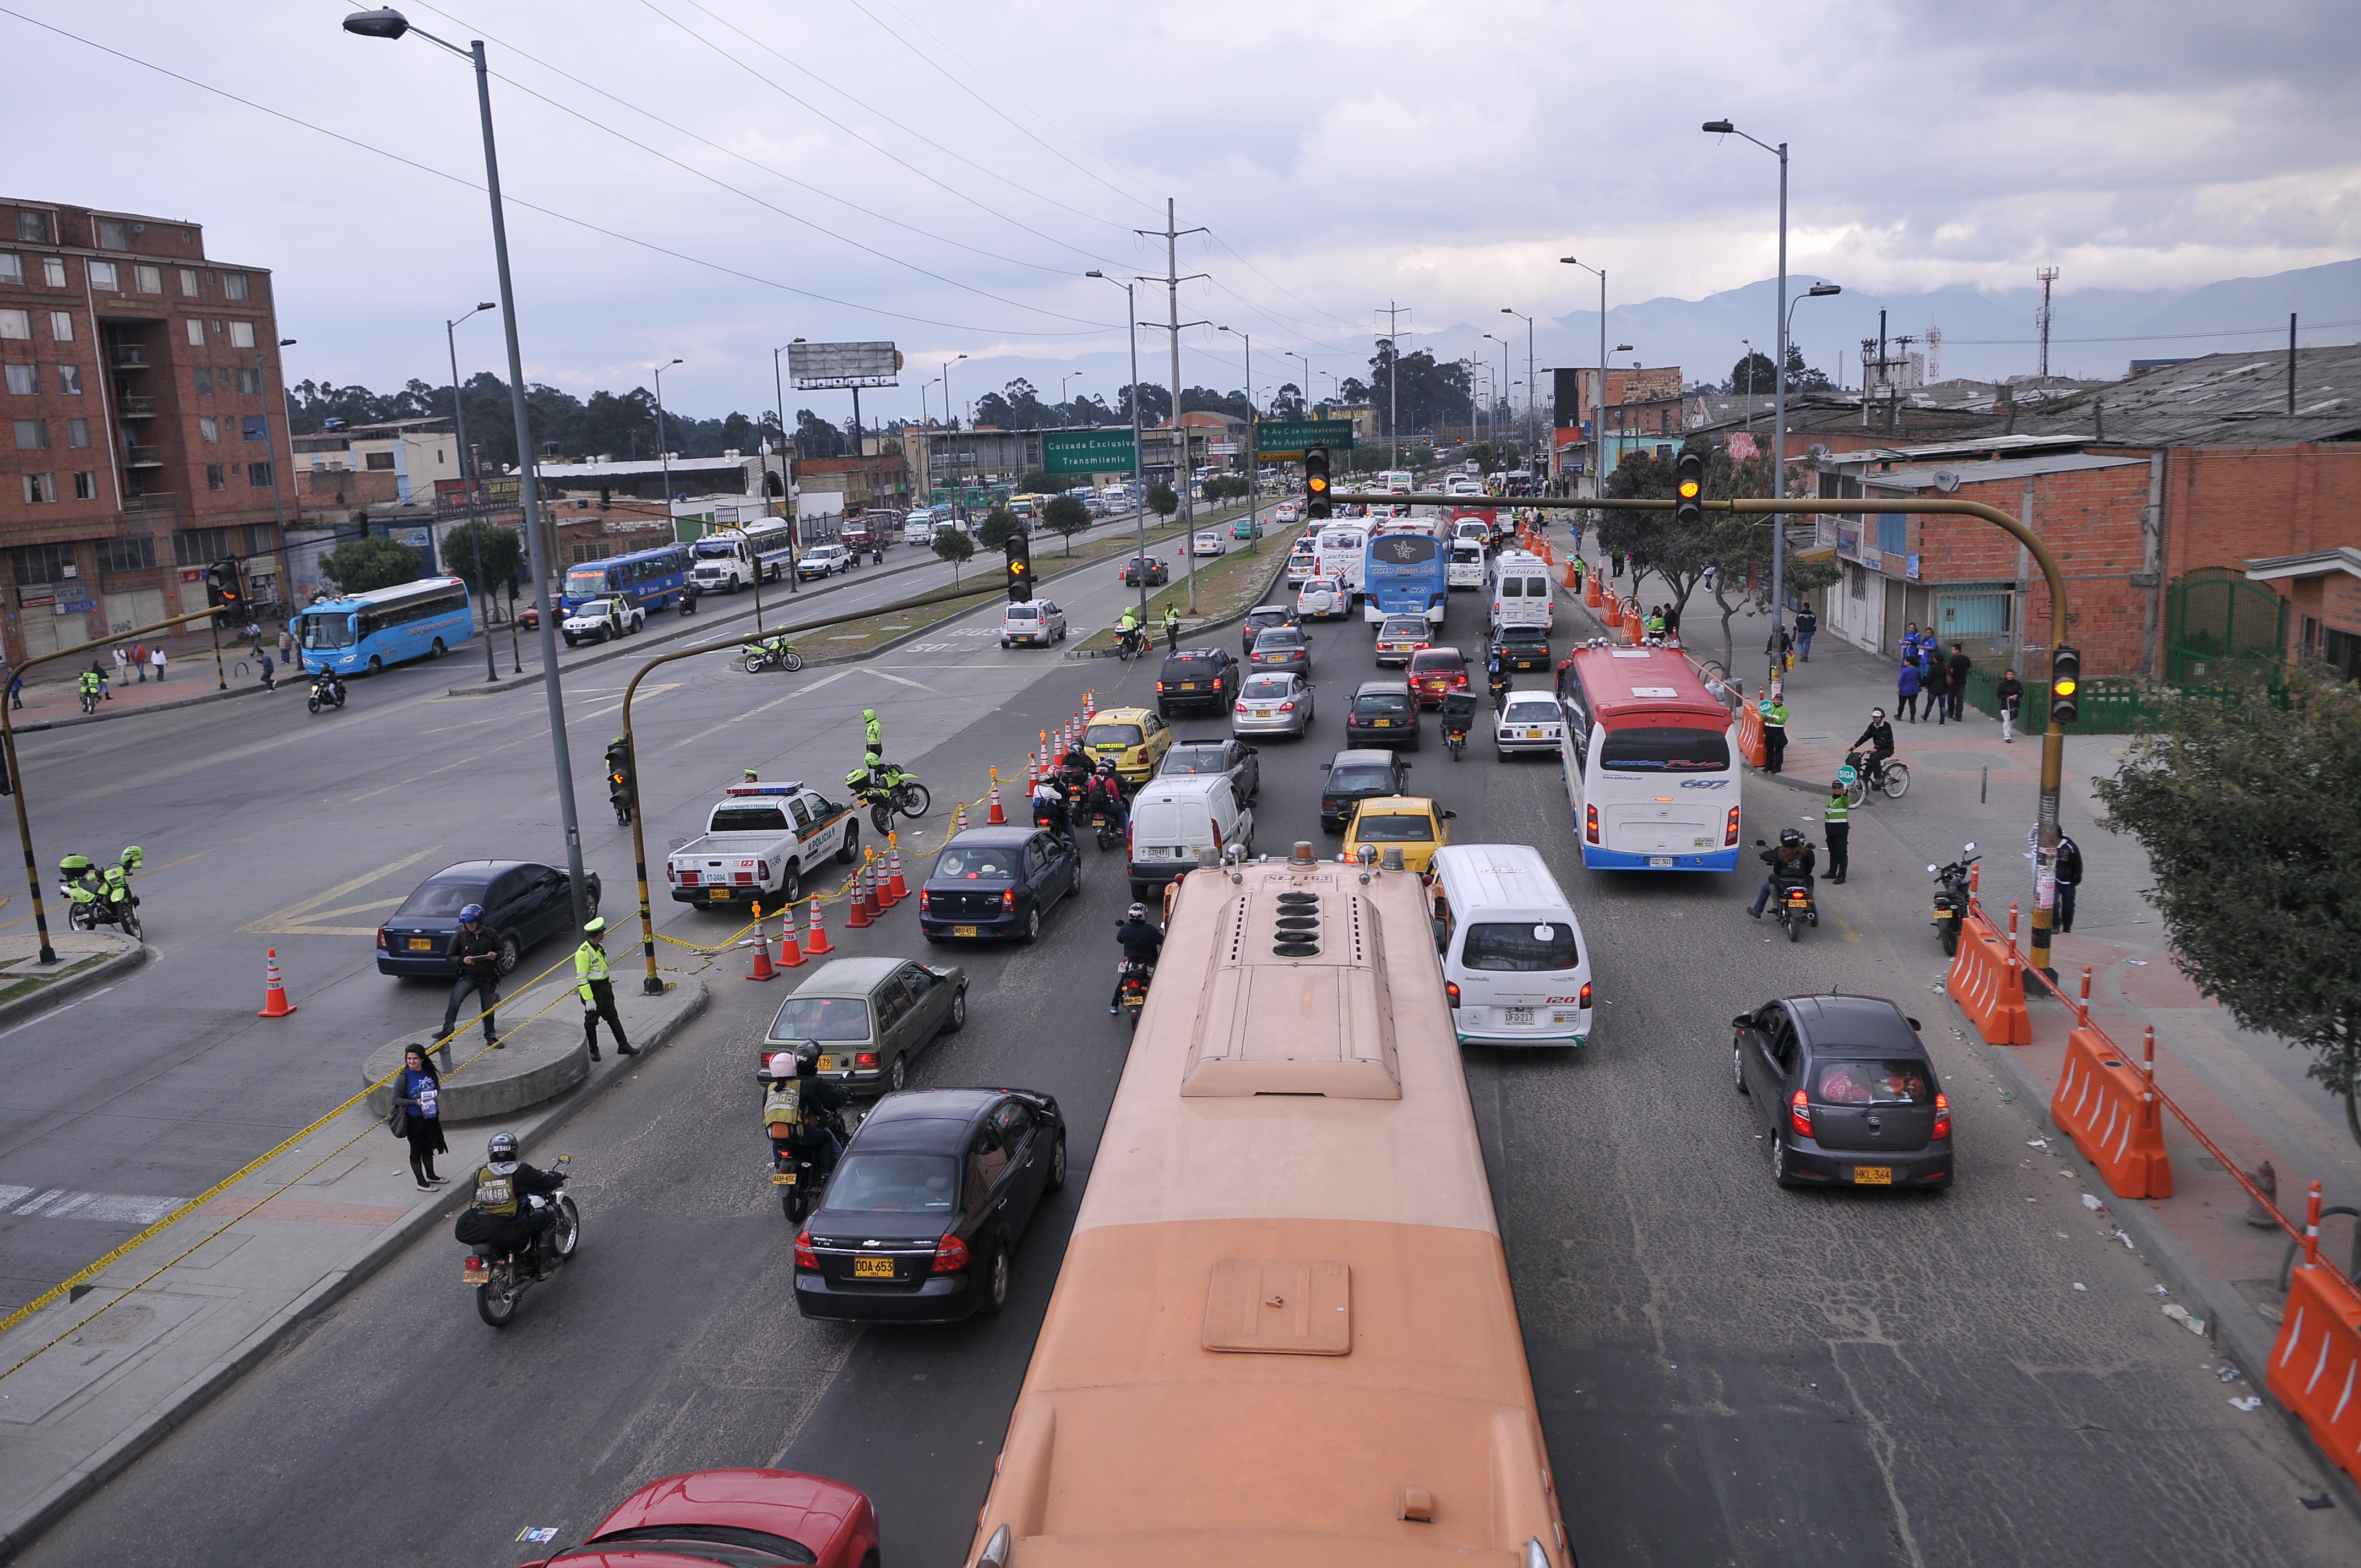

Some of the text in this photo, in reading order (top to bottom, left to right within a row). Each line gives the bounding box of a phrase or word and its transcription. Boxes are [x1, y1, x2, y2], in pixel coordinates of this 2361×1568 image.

[1048, 439, 1135, 450] Calzada Exclusiva
[1062, 455, 1126, 465] Transmilenio
[1759, 703, 1772, 711] SIGA
[1838, 770, 1854, 779] SIGA
[1679, 779, 1730, 790] 697
[811, 832, 833, 850] POLICIA
[476, 1188, 509, 1201] DRM46A
